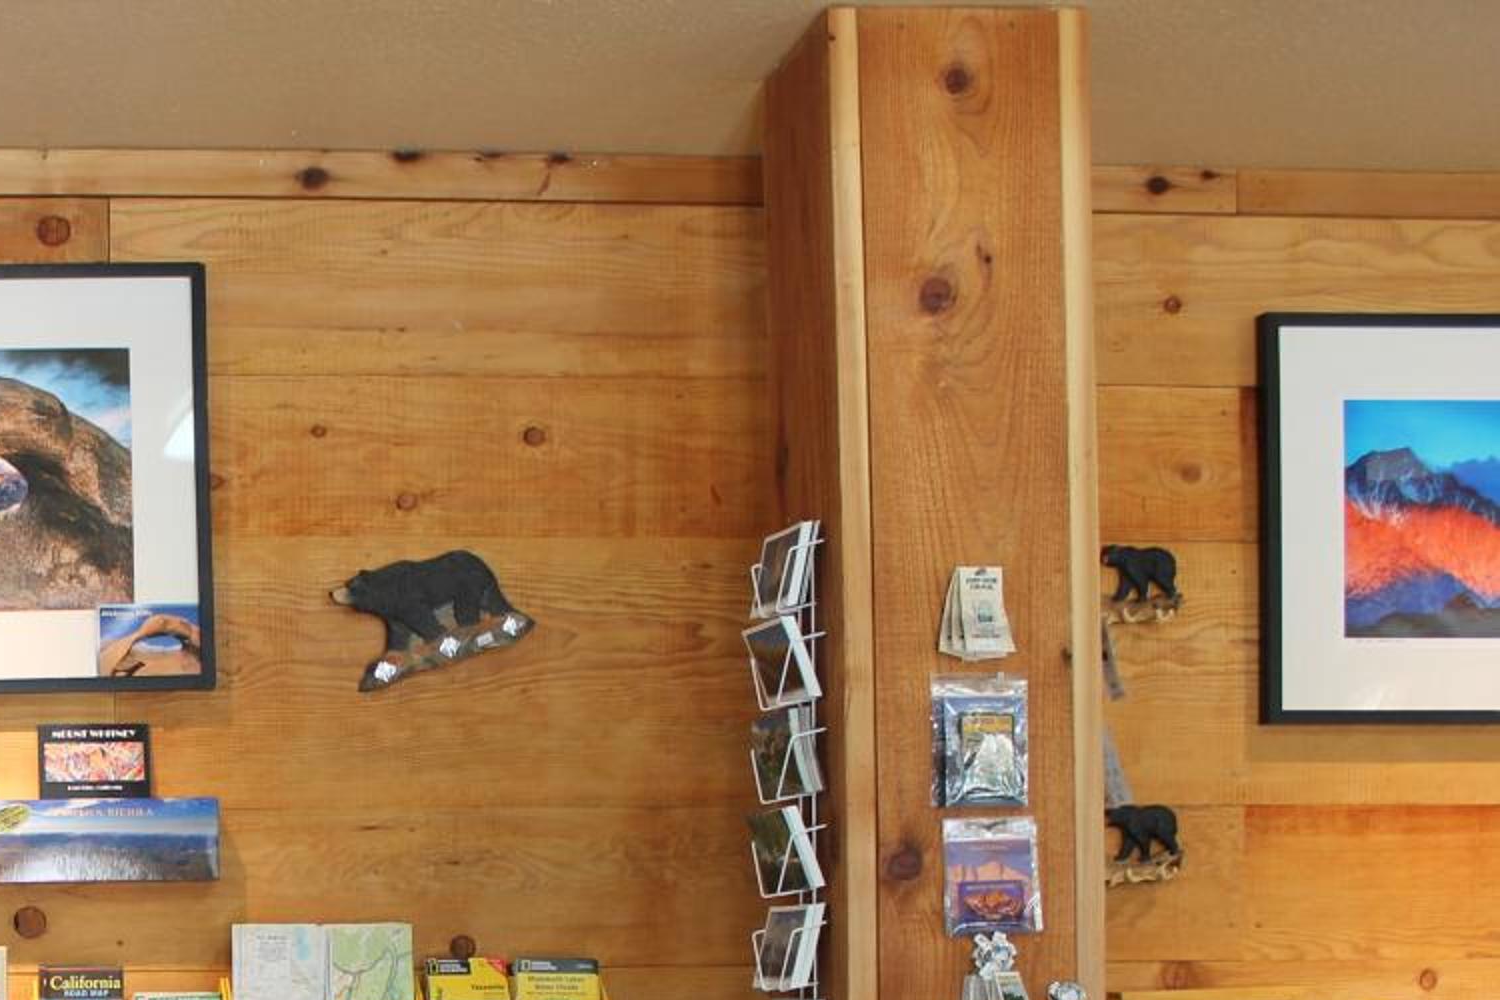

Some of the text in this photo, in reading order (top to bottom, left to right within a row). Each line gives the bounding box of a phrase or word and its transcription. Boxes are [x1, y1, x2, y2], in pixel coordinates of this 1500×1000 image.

[51, 729, 136, 739] MOUNT WHITNEY
[50, 975, 122, 991] California
